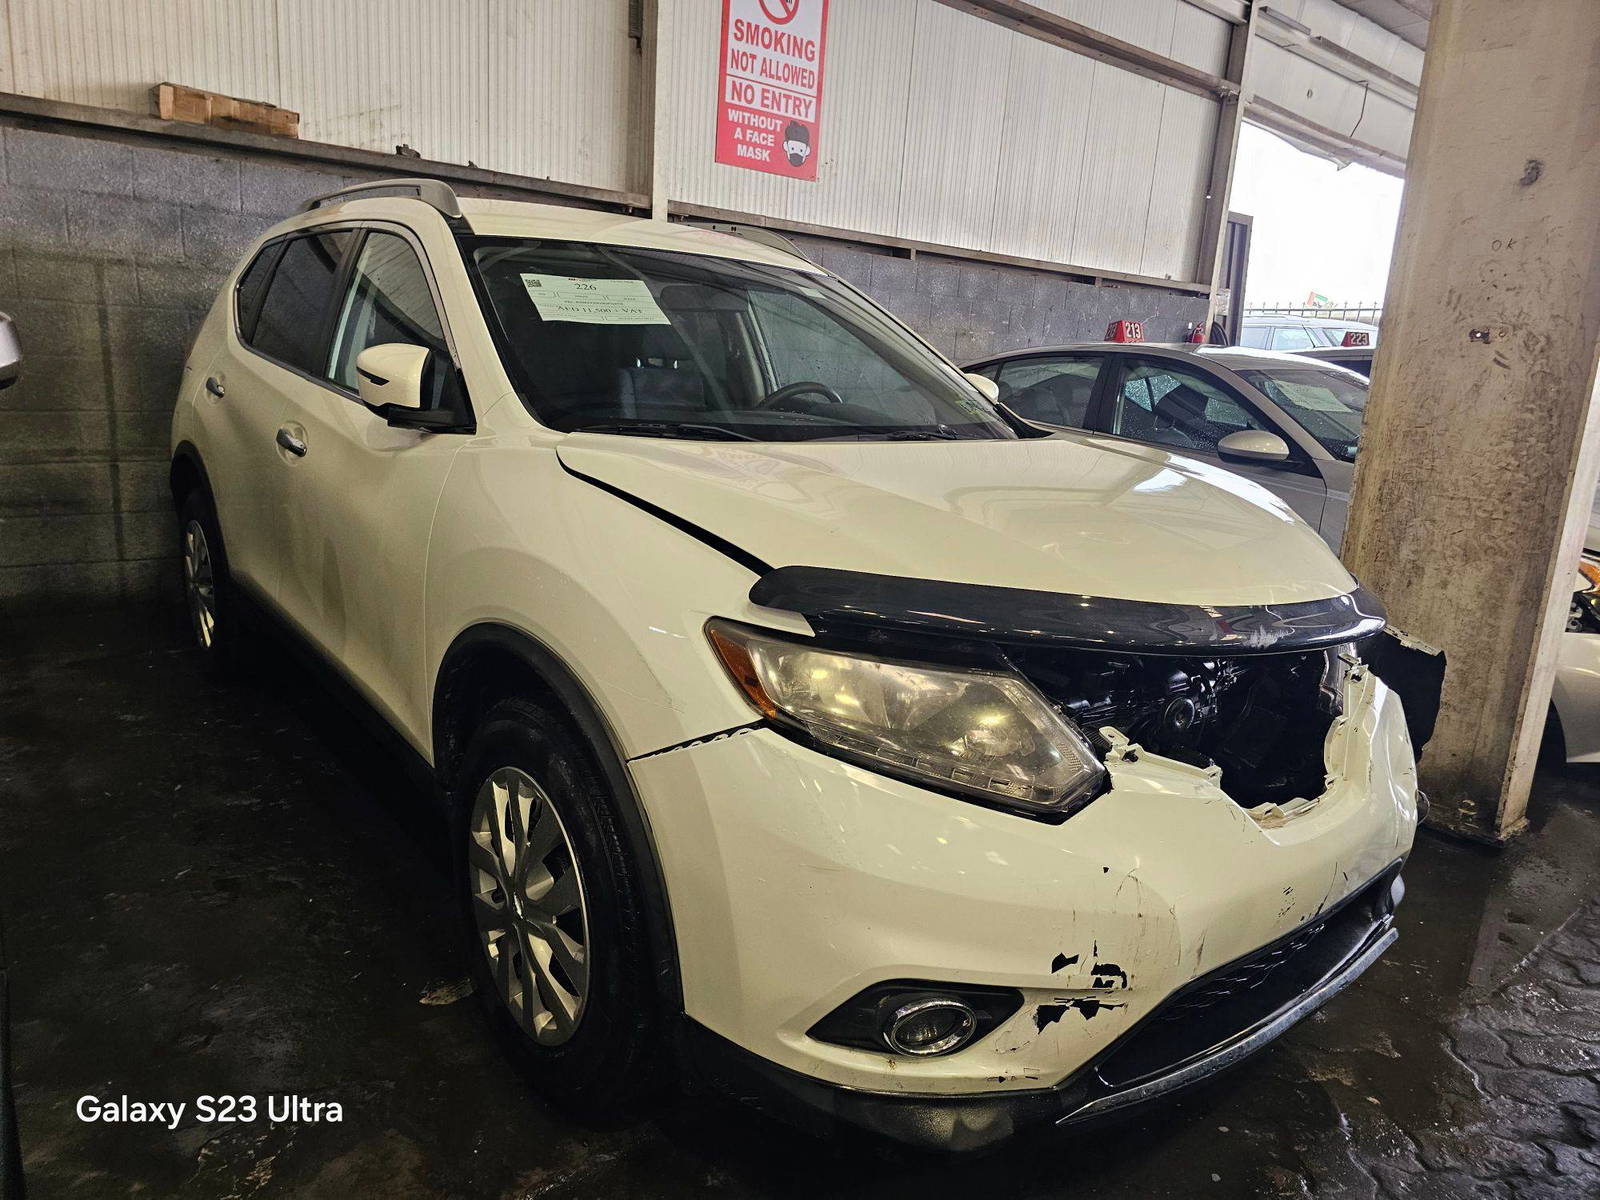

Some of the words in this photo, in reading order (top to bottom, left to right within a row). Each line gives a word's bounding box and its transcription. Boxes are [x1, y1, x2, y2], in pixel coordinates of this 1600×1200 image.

[733, 18, 816, 62] SMOKING
[730, 48, 757, 74] NOT
[760, 57, 815, 90] ALLOWED
[731, 80, 755, 105] NO
[760, 87, 812, 119] ENTRY
[728, 108, 782, 132] WITHOUT
[734, 127, 743, 140] A
[746, 131, 775, 147] FACE
[737, 144, 770, 162] MASK
[574, 283, 597, 291] 226
[1125, 322, 1141, 339] 213
[1350, 332, 1369, 345] 223
